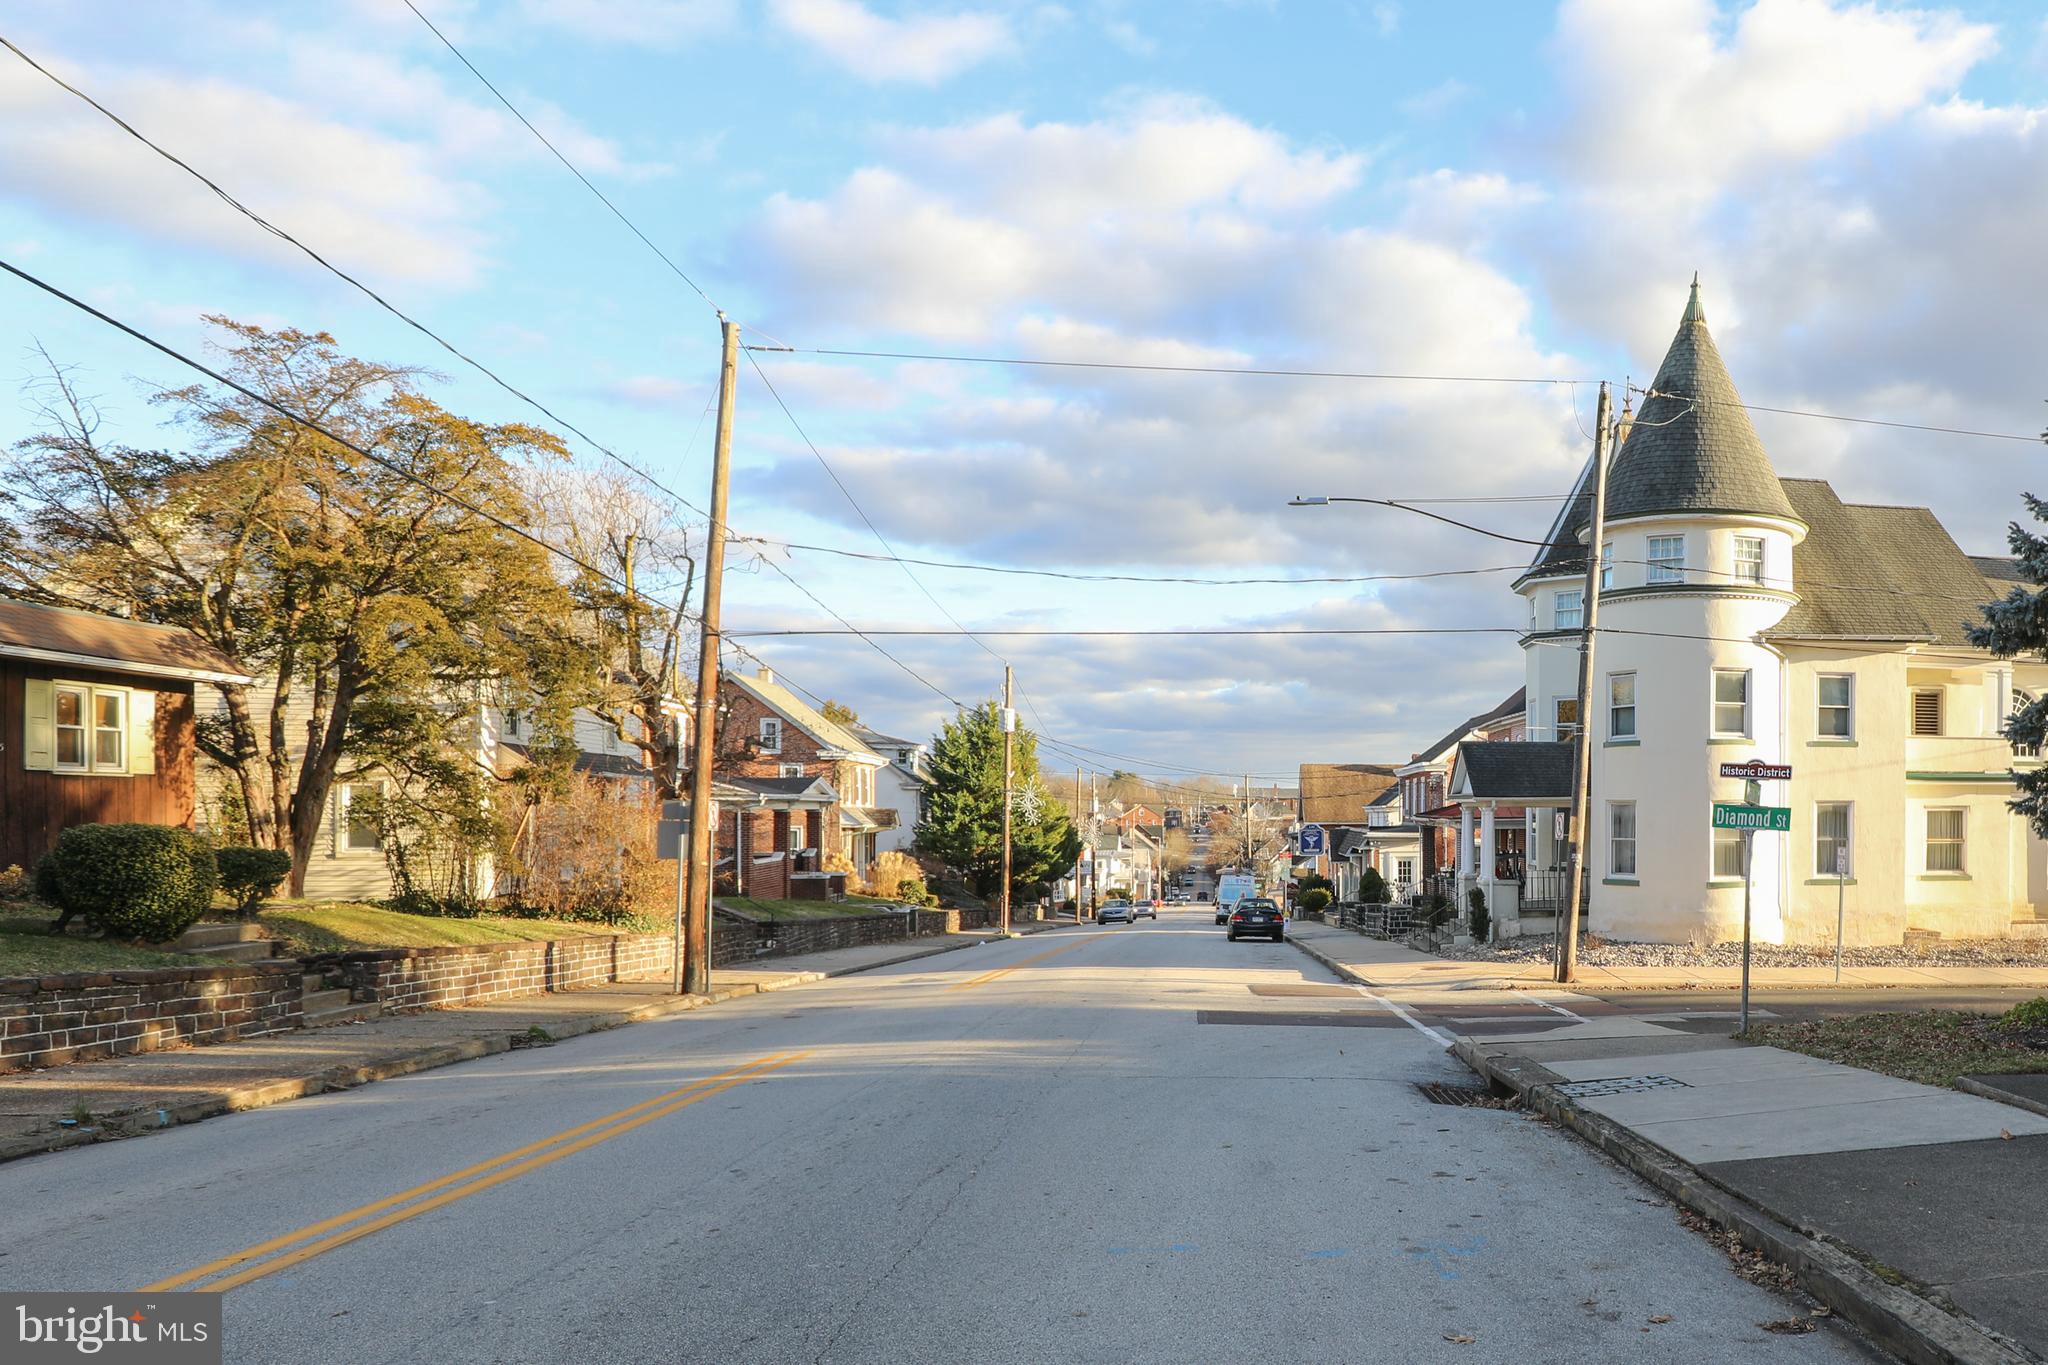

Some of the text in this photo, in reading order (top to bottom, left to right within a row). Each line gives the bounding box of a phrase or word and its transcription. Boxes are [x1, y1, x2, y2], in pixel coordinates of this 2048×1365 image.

[1721, 766, 1790, 778] Historic District
[1716, 807, 1787, 828] Diamond St
